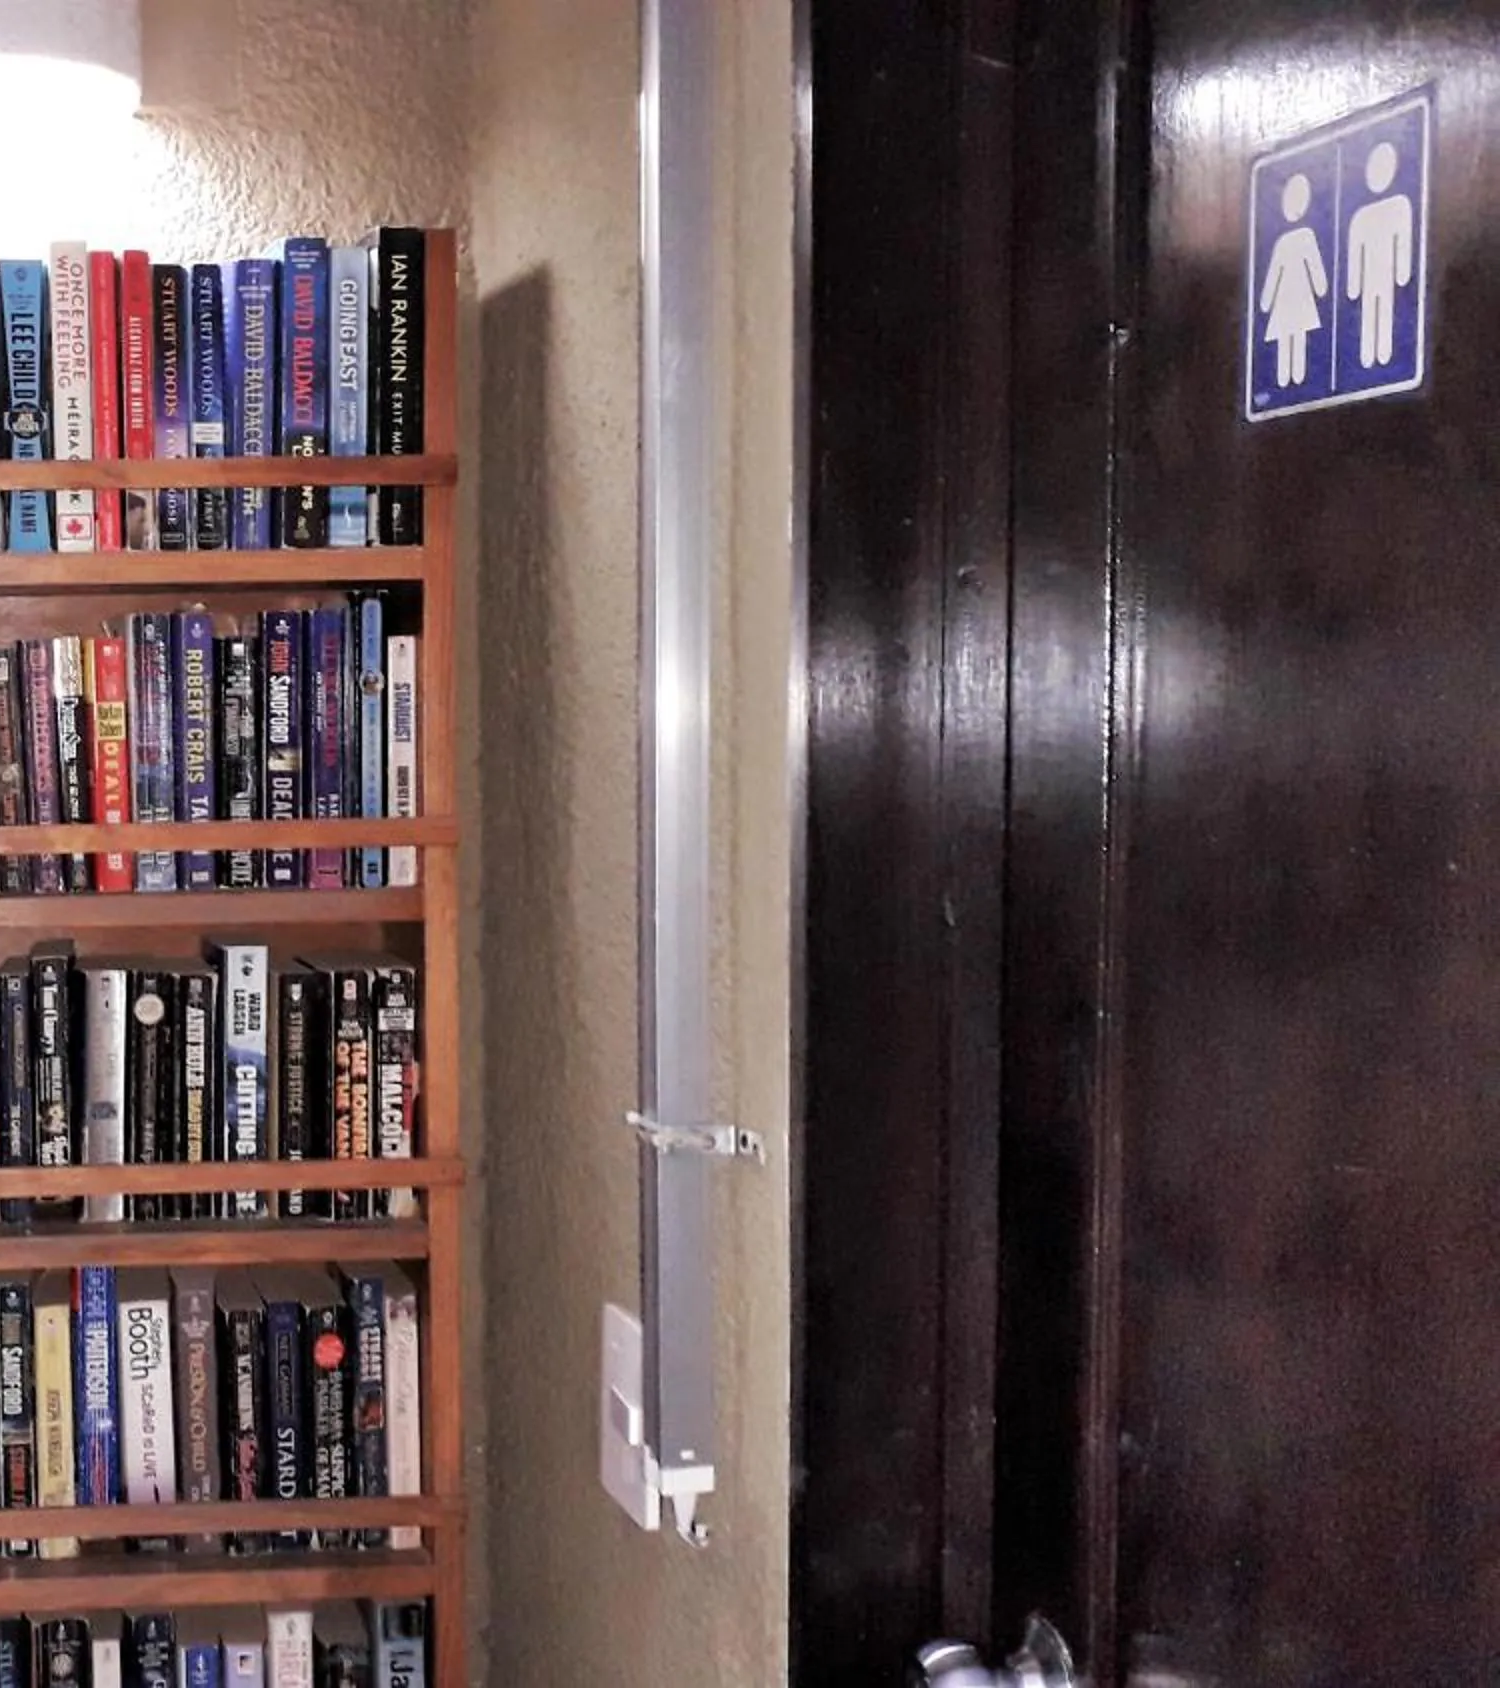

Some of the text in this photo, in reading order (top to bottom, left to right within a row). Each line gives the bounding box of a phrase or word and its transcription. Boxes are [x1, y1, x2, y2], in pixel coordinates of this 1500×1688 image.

[57, 255, 73, 389] WITH FEELING
[70, 262, 87, 382] ONCE MORE
[243, 304, 264, 361] DAVID
[293, 275, 315, 329] DAVID
[340, 279, 359, 338] GOING
[391, 254, 408, 382] IAN RANKIN
[11, 312, 39, 399] LEE CHILD
[162, 277, 178, 417] STUART WOODS
[199, 277, 216, 416] STUART WOODS
[341, 343, 358, 390] EAST
[293, 337, 316, 427] BALDACCI
[391, 392, 404, 426] EXIT
[186, 649, 206, 720] ROBERT
[269, 640, 292, 744] JOHN SANDFORD
[393, 682, 413, 743] STARDUST
[103, 741, 120, 805] DEAL
[187, 727, 207, 784] CRAIS
[186, 1006, 205, 1042] ANN
[247, 993, 261, 1031] WARD
[186, 1043, 205, 1087] RULE
[337, 1042, 351, 1067] OF
[235, 1065, 257, 1155] CUTTING
[337, 1072, 351, 1109] THE
[352, 1040, 368, 1161] THE BONFIR
[381, 1064, 403, 1158] MALCOL
[127, 1306, 158, 1381] Booth
[2, 1346, 24, 1415] SANDFORD
[331, 1443, 345, 1498] SUSPIC
